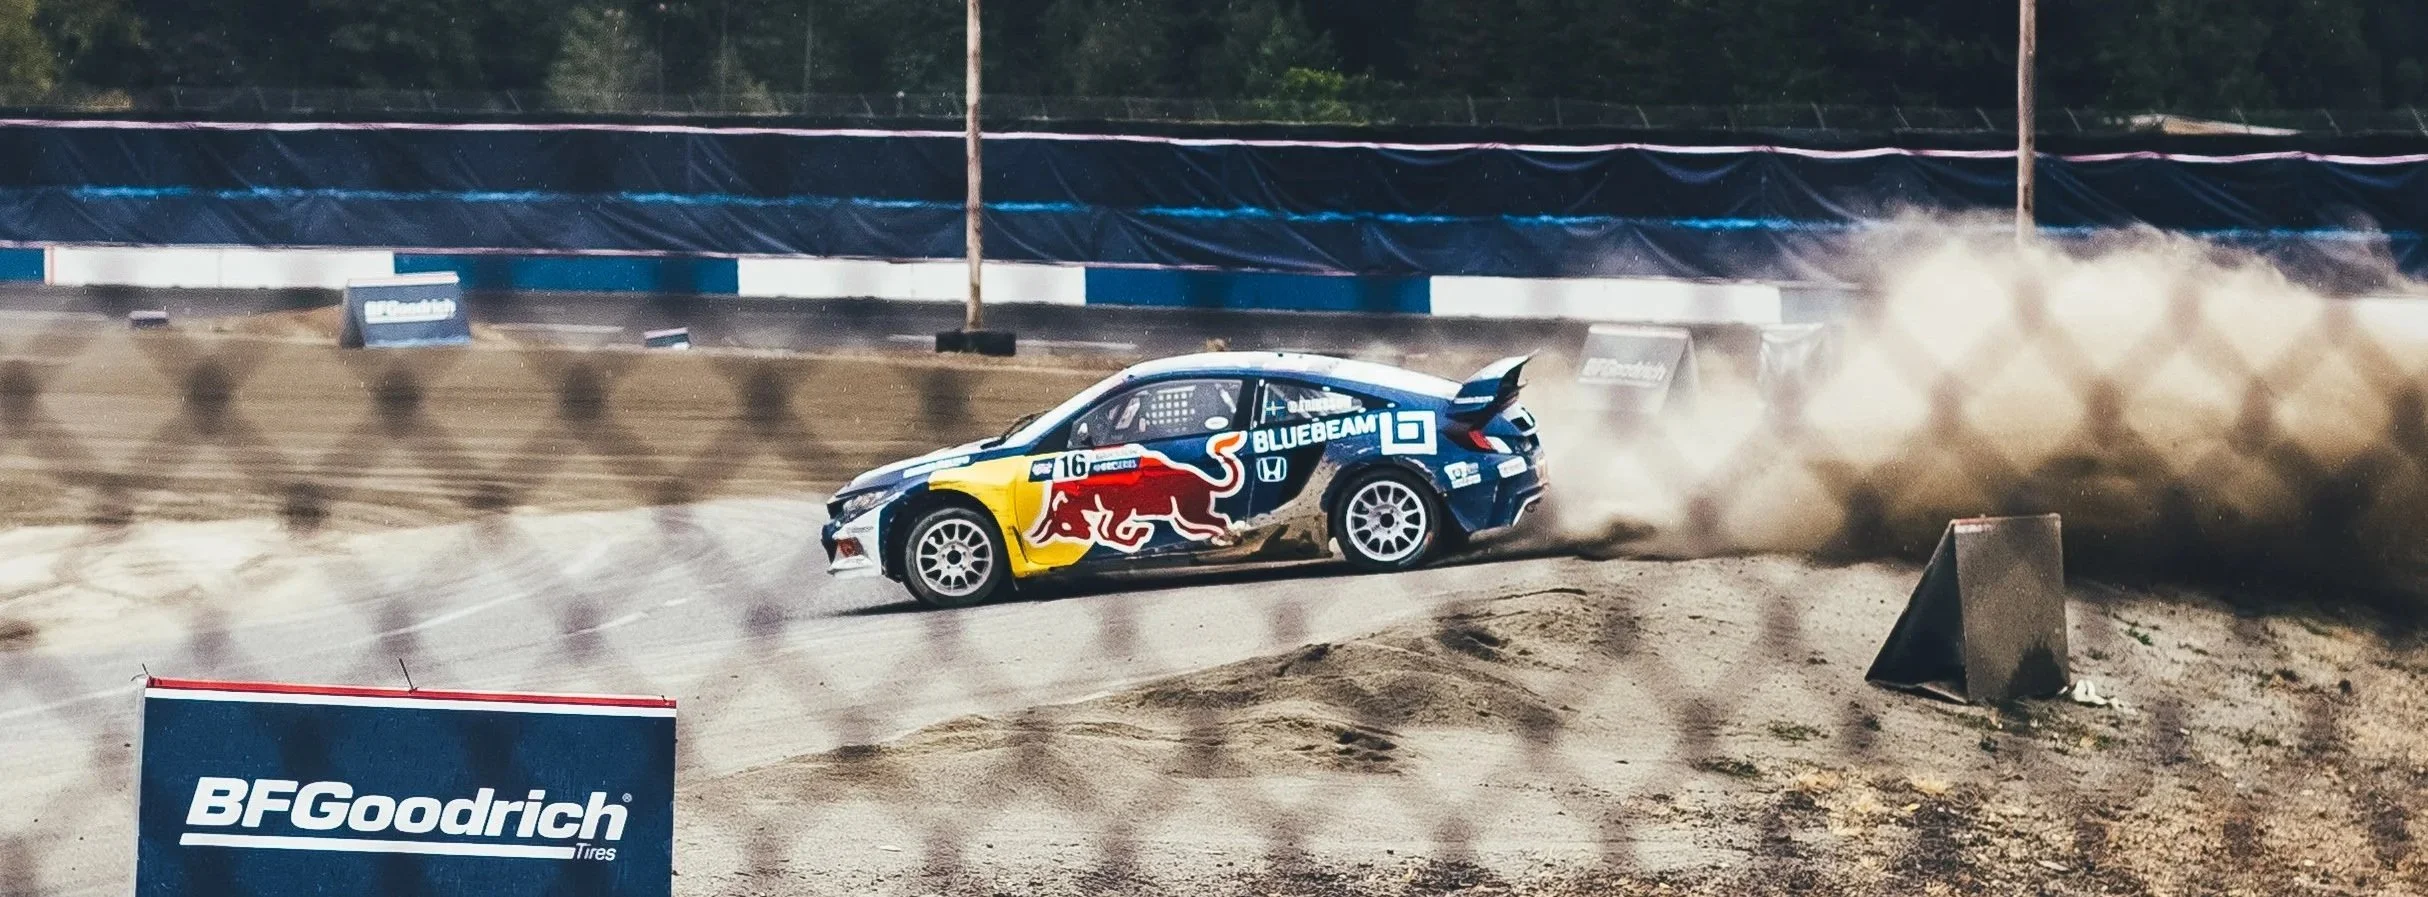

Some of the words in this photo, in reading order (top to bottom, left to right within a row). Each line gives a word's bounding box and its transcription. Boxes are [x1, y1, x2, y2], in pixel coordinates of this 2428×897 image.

[1252, 415, 1377, 454] BLUEBEAM
[1060, 454, 1087, 477] 16
[185, 776, 630, 841] BFGoodrich
[575, 842, 617, 861] Tires
